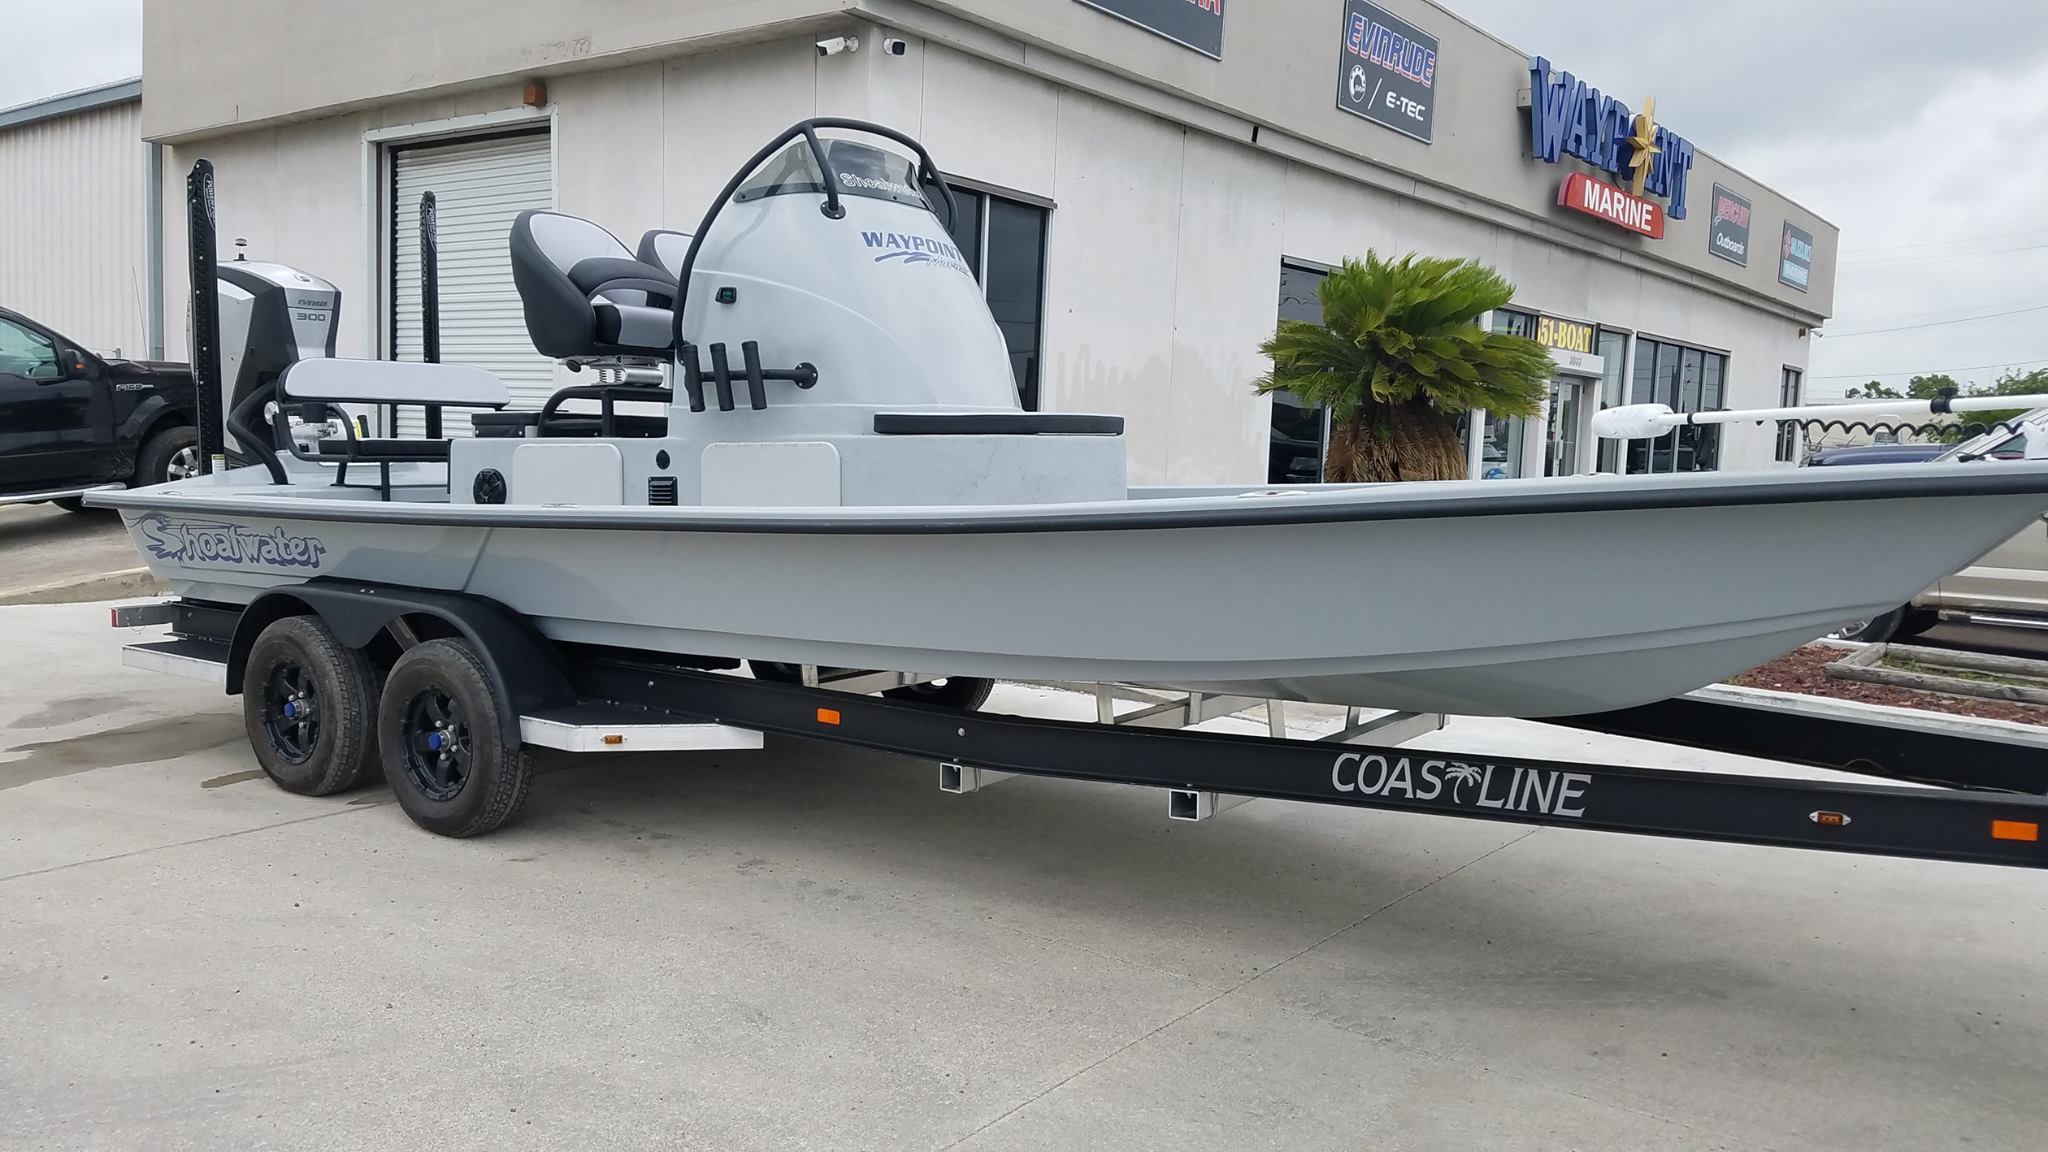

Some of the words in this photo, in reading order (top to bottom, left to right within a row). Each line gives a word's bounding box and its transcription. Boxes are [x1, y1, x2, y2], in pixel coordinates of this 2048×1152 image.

[1347, 12, 1436, 88] EVINRUDE
[1386, 91, 1425, 121] E-TEC
[1584, 179, 1653, 231] MARINE
[861, 231, 964, 262] WAYPOINT
[296, 312, 326, 322] 300
[141, 512, 327, 569] Shoalwater
